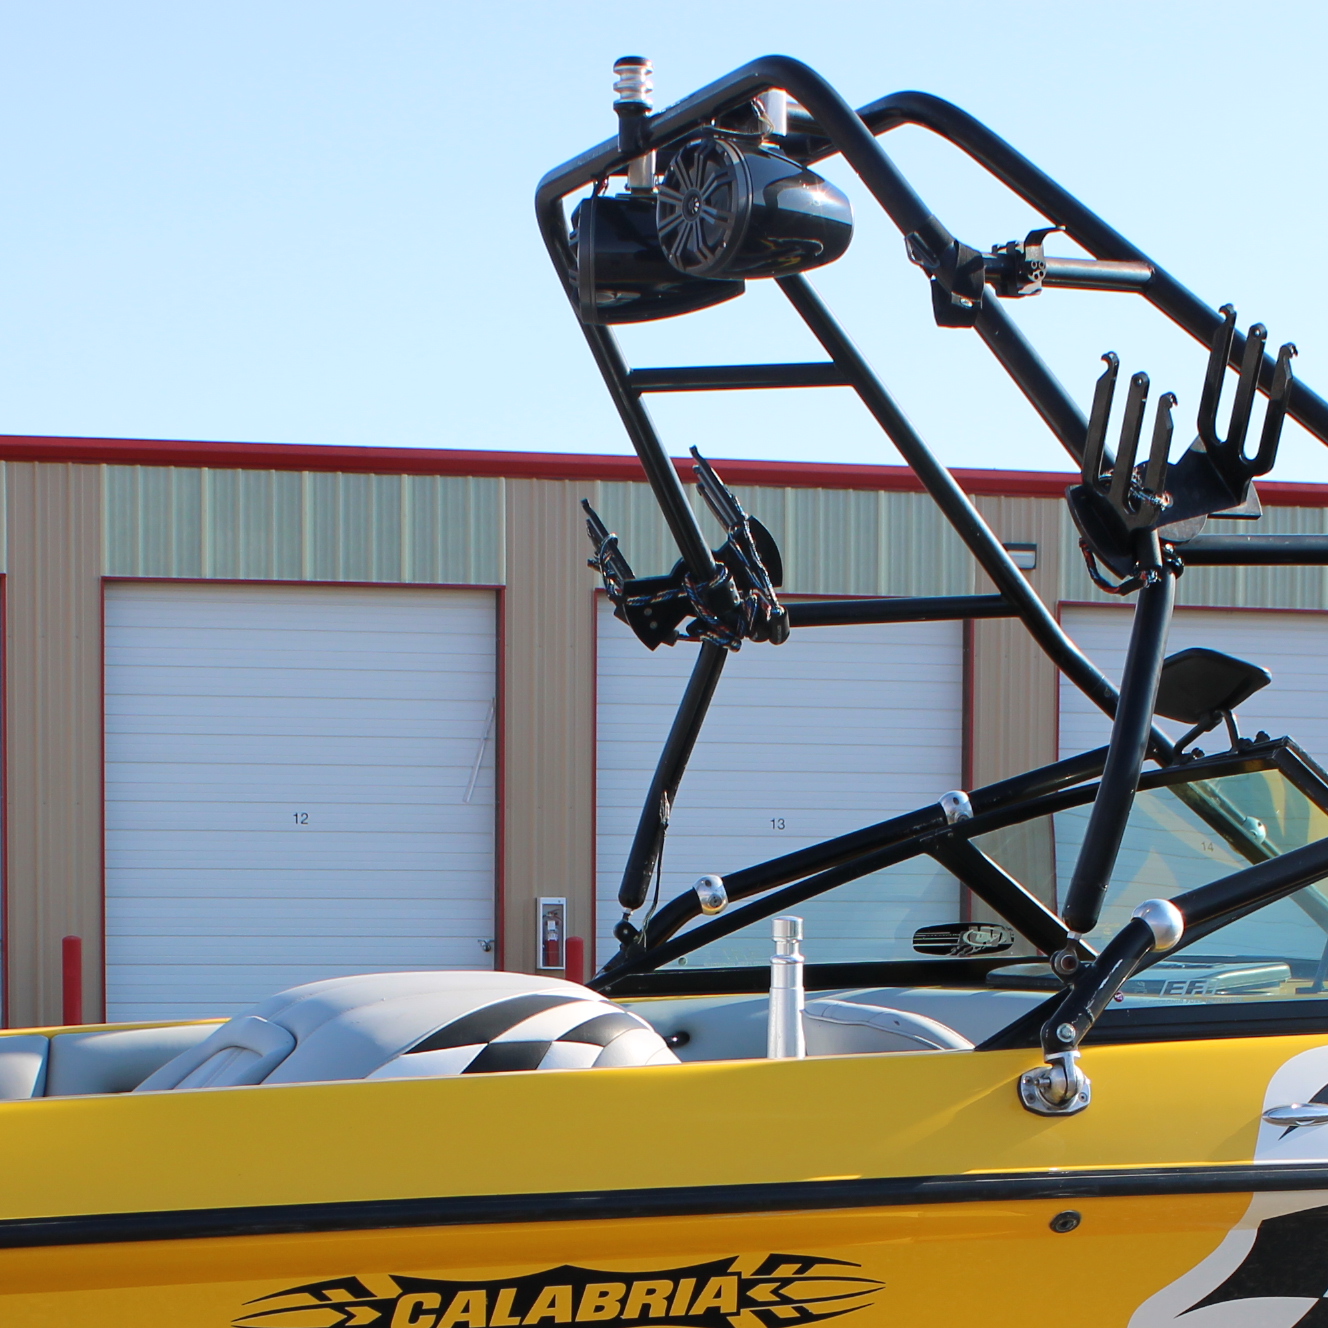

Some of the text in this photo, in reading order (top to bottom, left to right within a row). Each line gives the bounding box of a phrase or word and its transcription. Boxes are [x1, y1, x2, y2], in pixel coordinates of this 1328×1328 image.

[293, 812, 309, 825] 12
[770, 818, 786, 831] 13
[1201, 841, 1214, 852] 14
